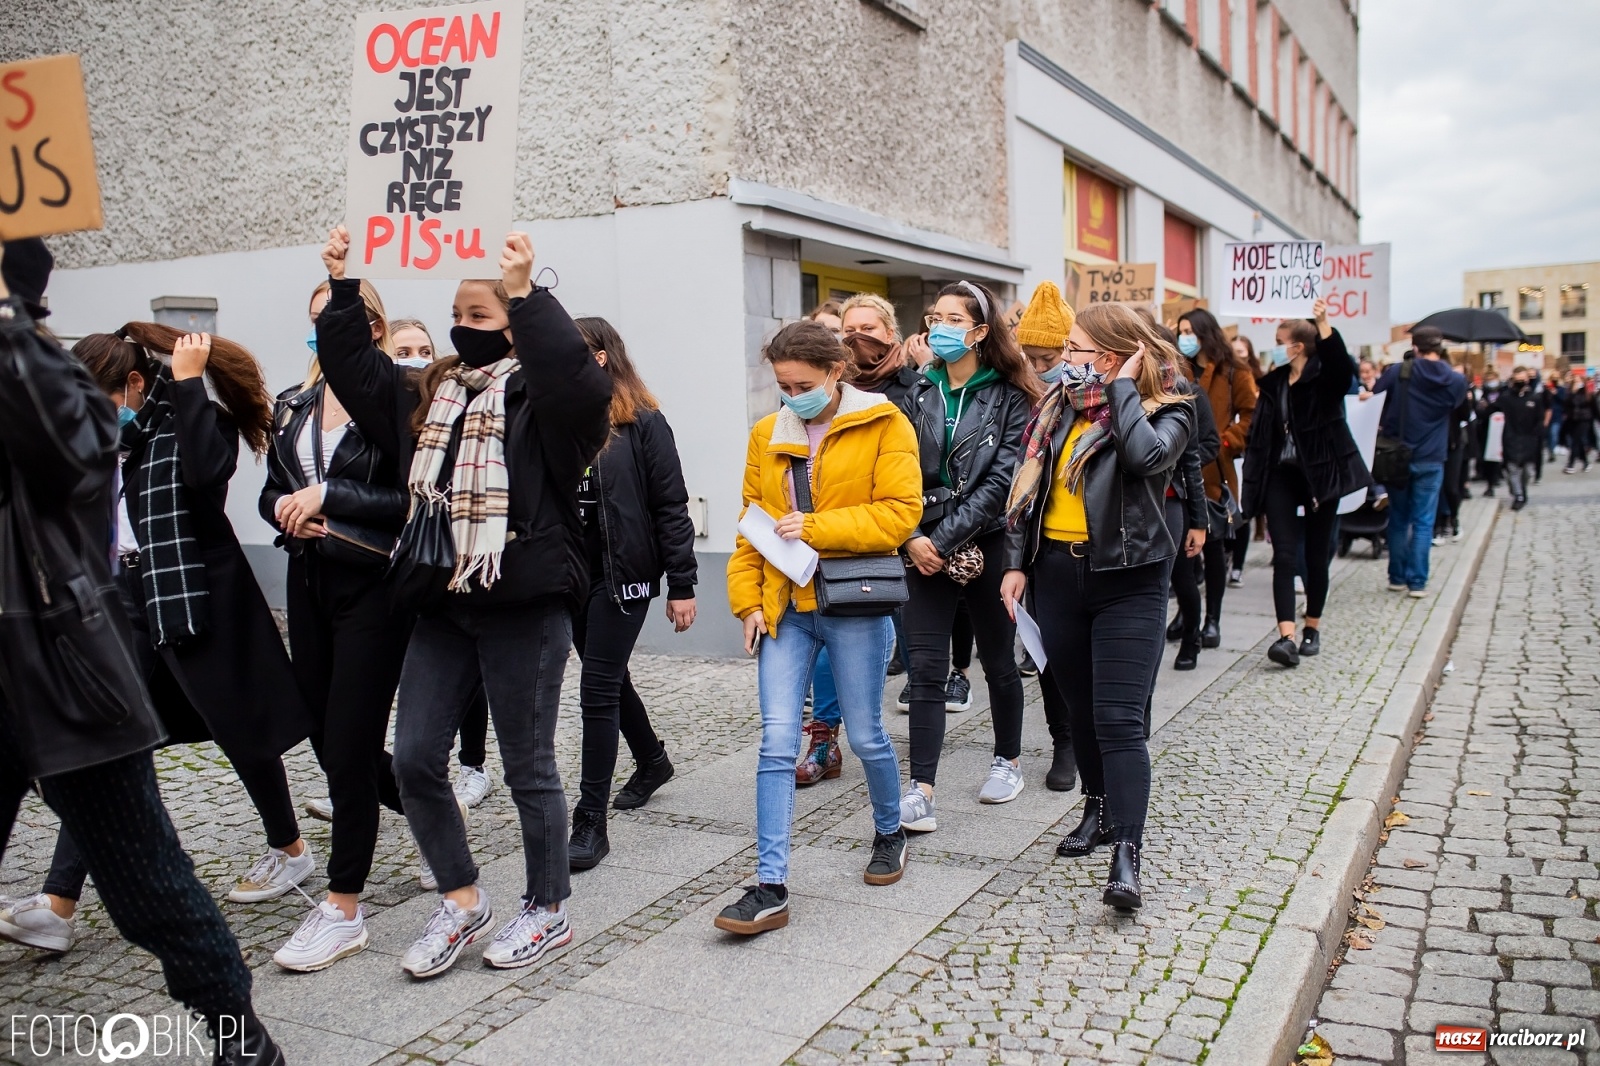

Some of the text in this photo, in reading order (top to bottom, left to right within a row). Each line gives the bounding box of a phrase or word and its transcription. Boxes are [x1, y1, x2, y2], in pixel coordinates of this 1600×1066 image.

[366, 11, 501, 74] OCEAN
[393, 66, 472, 114] JEST
[359, 104, 493, 157] CZYSTSZY
[386, 179, 463, 221] RĘCE
[1232, 242, 1322, 271] MOJE CIAŁO
[1087, 265, 1136, 287] TWÓJ
[1231, 272, 1321, 303] MÓJ WYBÓR
[622, 582, 650, 600] LOW
